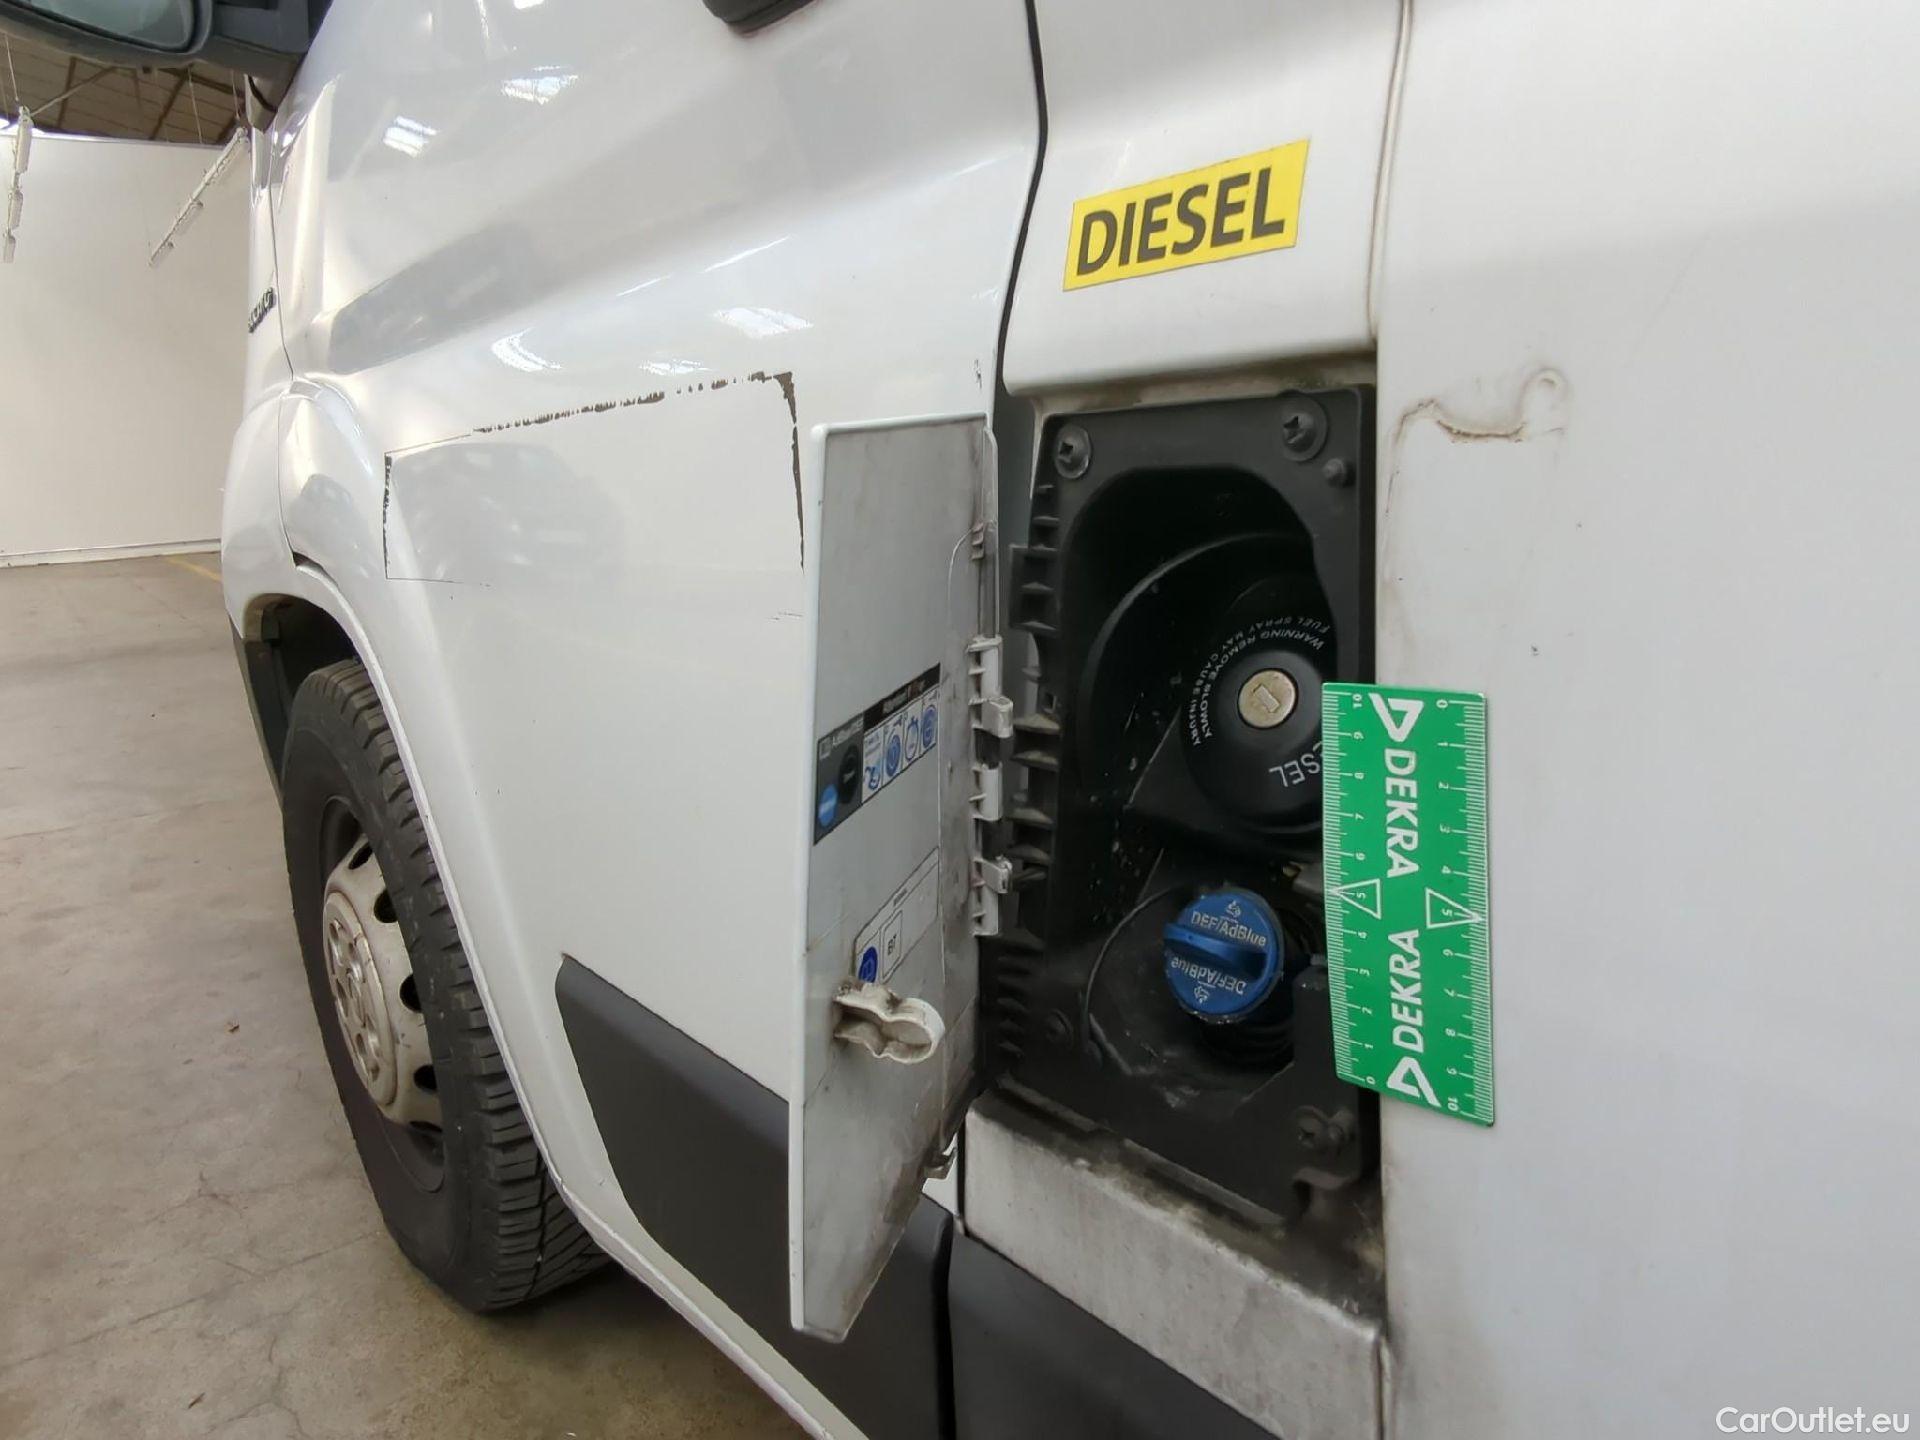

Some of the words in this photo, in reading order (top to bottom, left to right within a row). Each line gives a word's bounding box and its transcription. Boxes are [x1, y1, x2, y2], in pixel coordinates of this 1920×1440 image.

[1076, 167, 1285, 276] DIESEL
[1249, 616, 1293, 633] SPRAY
[1297, 616, 1331, 634] FUEL
[1260, 628, 1325, 650] WARNING
[1208, 635, 1256, 682] REMOVE
[1352, 693, 1362, 709] 10
[1436, 700, 1448, 709] 0
[1353, 731, 1364, 740] 9
[1354, 772, 1365, 780] 8
[1438, 782, 1449, 790] 2
[1355, 813, 1365, 821] 7
[1384, 748, 1419, 878] DEKRA
[1439, 824, 1450, 833] 3
[1355, 852, 1366, 861] 6
[1441, 866, 1451, 875] 4
[1356, 892, 1366, 900] 5
[1441, 908, 1453, 917] 5
[1191, 911, 1267, 947] DEF/AdBlue
[1358, 931, 1368, 939] 4
[1442, 949, 1454, 957] 6
[1171, 956, 1247, 995] DEF/AdBlue
[1359, 968, 1370, 977] 3
[1387, 929, 1424, 1053] DEKRA
[1444, 988, 1456, 997] 7
[1361, 1007, 1373, 1015] 2
[1445, 1028, 1456, 1037] 8
[1446, 1067, 1457, 1076] 9
[1366, 1076, 1376, 1085] 0
[1447, 1097, 1459, 1112] 10
